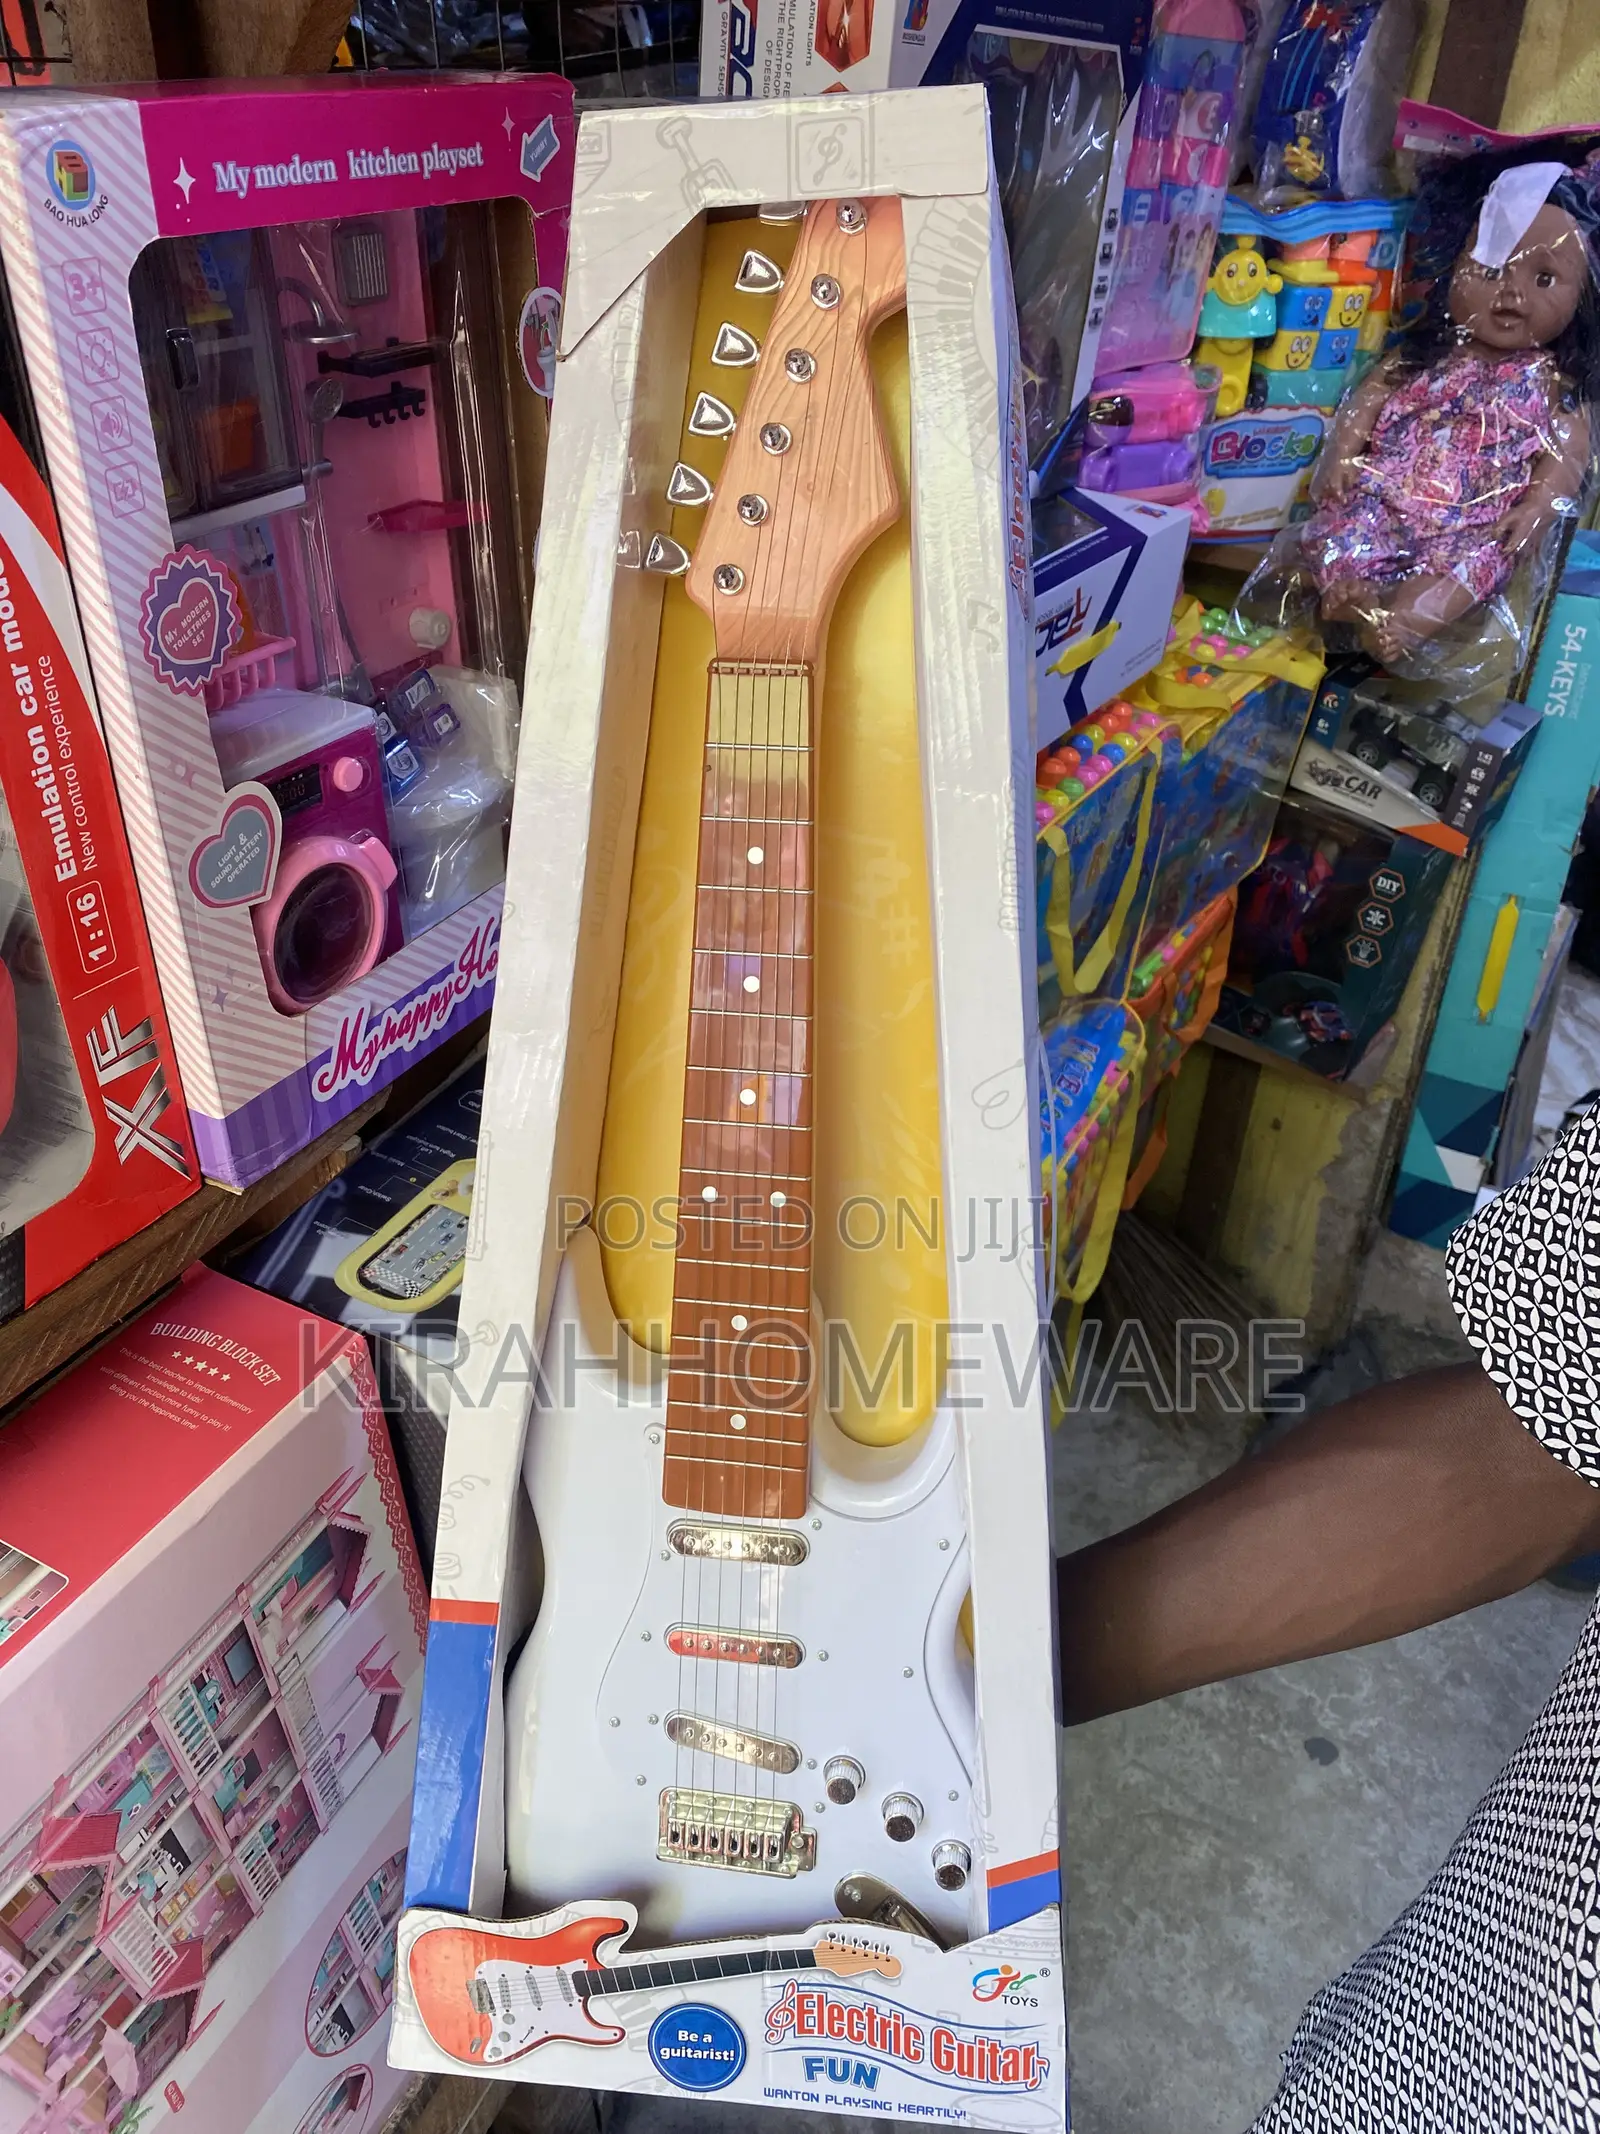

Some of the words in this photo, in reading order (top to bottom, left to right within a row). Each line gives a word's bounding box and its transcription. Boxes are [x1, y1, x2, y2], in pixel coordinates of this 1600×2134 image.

[777, 2, 786, 24] THE
[719, 11, 729, 60] GRAVITY
[765, 40, 773, 56] OF
[806, 32, 814, 66] LIGHTS
[773, 28, 785, 98] RIGHTPROP
[784, 62, 793, 78] OF
[212, 162, 249, 198] My
[254, 154, 338, 189] modern
[347, 146, 420, 180] kitchen
[421, 141, 484, 180] playset
[44, 198, 65, 222] BAO
[66, 214, 88, 228] HUA
[88, 194, 109, 224] LONG
[69, 272, 104, 302] 3+
[172, 610, 212, 652] TOILETRIES
[181, 596, 209, 629] MODERN
[191, 630, 205, 647] SET
[1544, 623, 1587, 718] 54-KEYS
[10, 663, 38, 718] car
[38, 654, 72, 761] experience
[27, 724, 78, 883] Emulation
[58, 762, 88, 827] control
[1345, 776, 1383, 800] CAR
[80, 831, 98, 873] New
[210, 863, 232, 888] SOUND
[234, 829, 263, 863] BATTERY
[217, 844, 237, 867] LIGHT
[238, 832, 248, 846] &
[227, 846, 260, 883] OPERATED
[1376, 875, 1401, 892] DIY
[76, 891, 107, 963] 1:16
[86, 1005, 192, 1182] XF
[150, 1322, 222, 1347] BUILDING
[216, 1339, 264, 1370] BLOCK
[253, 1363, 282, 1386] SET
[109, 1383, 127, 1397] Bring
[125, 1393, 139, 1402] you
[138, 1398, 149, 1407] the
[148, 1402, 181, 1423] happiness
[113, 1371, 140, 1388] different
[181, 1404, 201, 1418] funny
[200, 1413, 208, 1421] to
[207, 1417, 223, 1429] play
[146, 1373, 180, 1394] knowledge
[179, 1389, 188, 1397] to
[148, 1360, 163, 1371] best
[162, 1367, 187, 1382] teacher
[214, 1392, 254, 1415] rudimentary
[1002, 1995, 1039, 2008] TOYS
[660, 2046, 735, 2061] guitarist!
[678, 2030, 699, 2042] Be
[702, 2033, 712, 2043] a
[794, 1991, 924, 2064] Electric
[931, 2026, 1042, 2089] Guitar
[802, 2055, 881, 2092] FUN
[763, 2087, 820, 2103] WANTON
[898, 2103, 967, 2120] HEARTILY!
